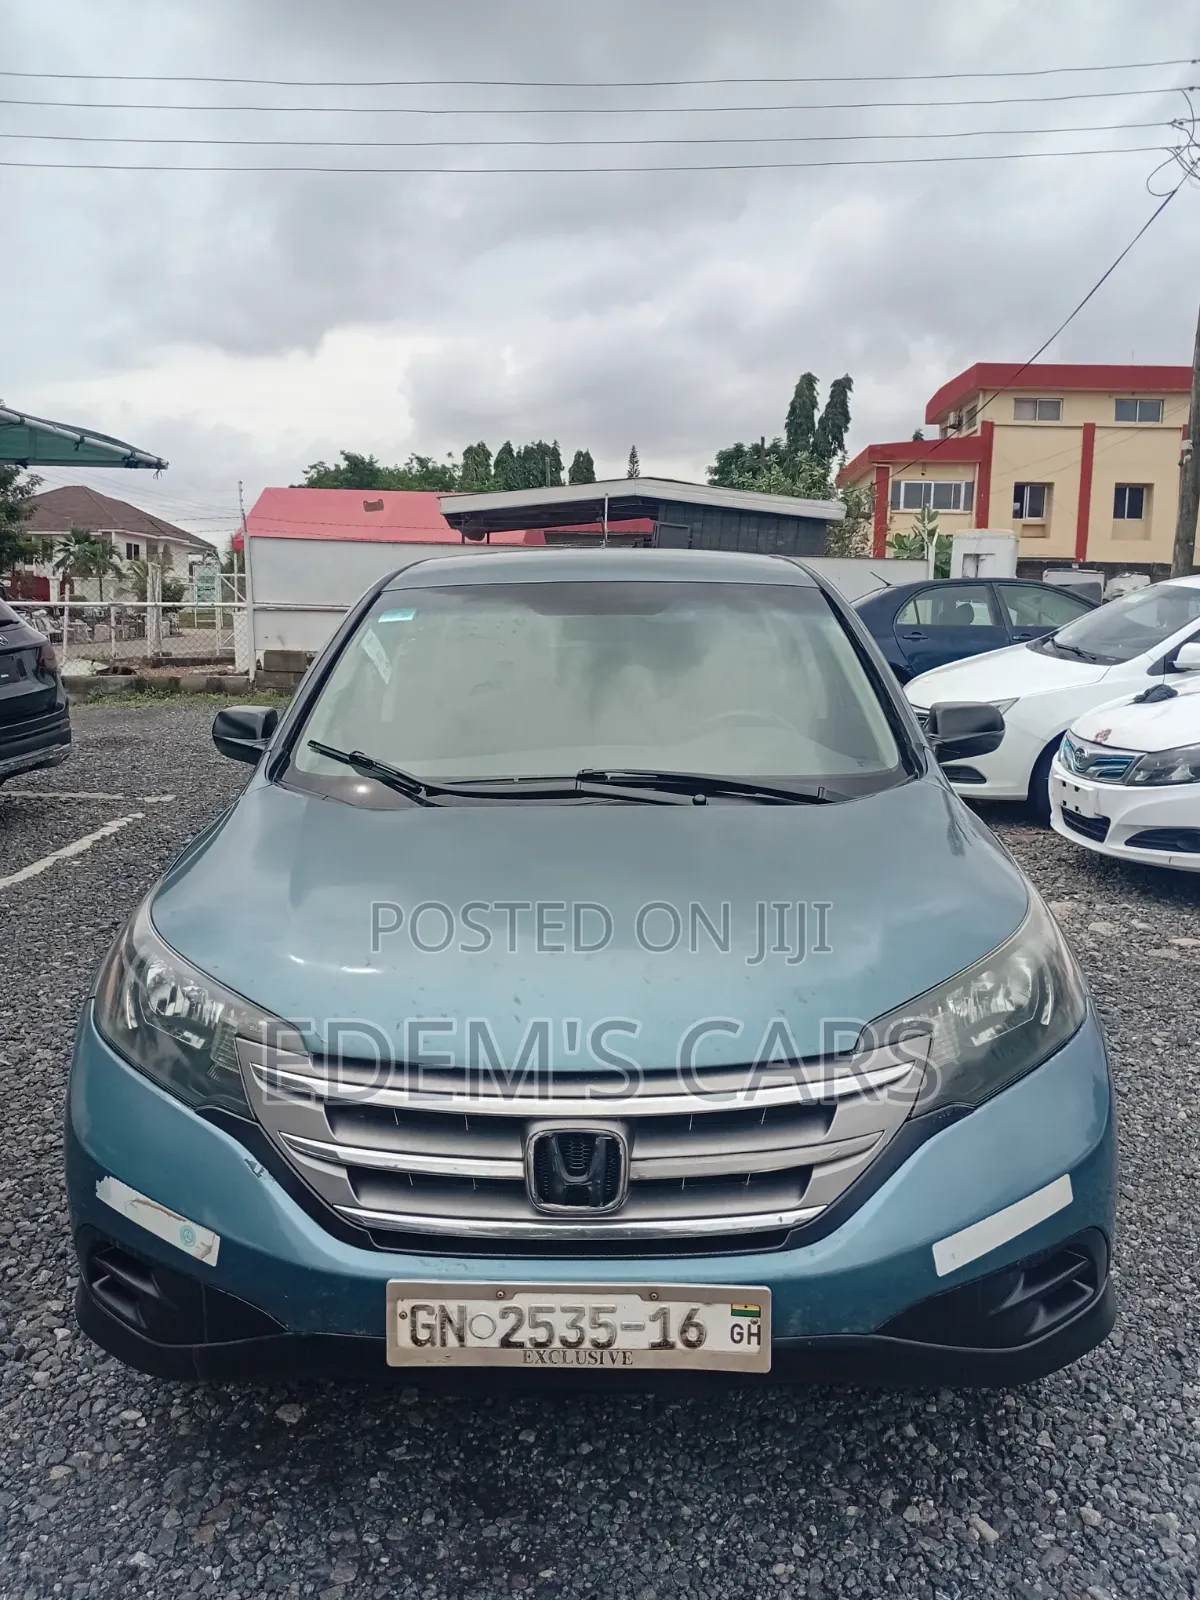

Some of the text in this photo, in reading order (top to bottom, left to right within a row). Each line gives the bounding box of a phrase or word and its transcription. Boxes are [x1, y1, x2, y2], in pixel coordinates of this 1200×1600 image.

[409, 1303, 708, 1350] GN 2535-16
[730, 1323, 762, 1346] GH
[522, 1349, 635, 1367] EXCLUSIVE
